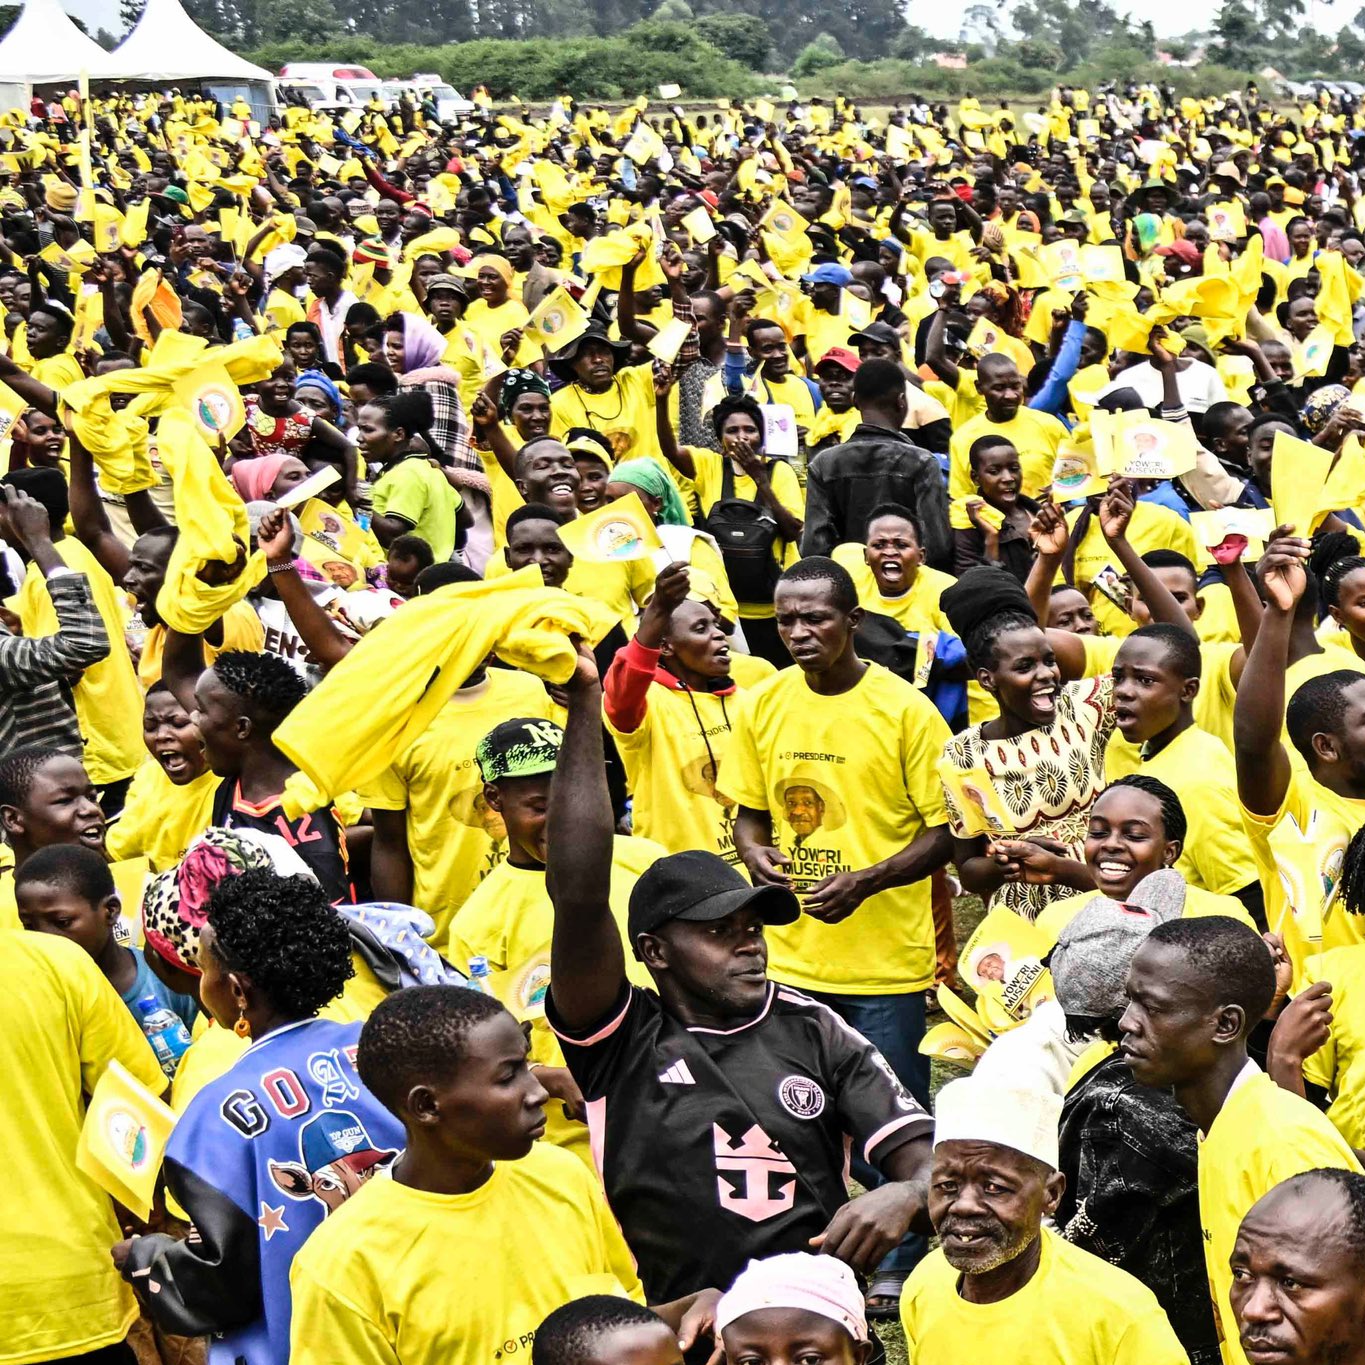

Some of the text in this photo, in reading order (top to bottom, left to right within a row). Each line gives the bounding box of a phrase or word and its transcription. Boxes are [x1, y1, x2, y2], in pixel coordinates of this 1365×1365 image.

[793, 751, 837, 764] PRESIDENT
[274, 813, 323, 848] 12
[789, 846, 843, 864] YOWERI
[1001, 963, 1033, 1001] YOWERI
[1007, 963, 1042, 1011] MUSEVENI
